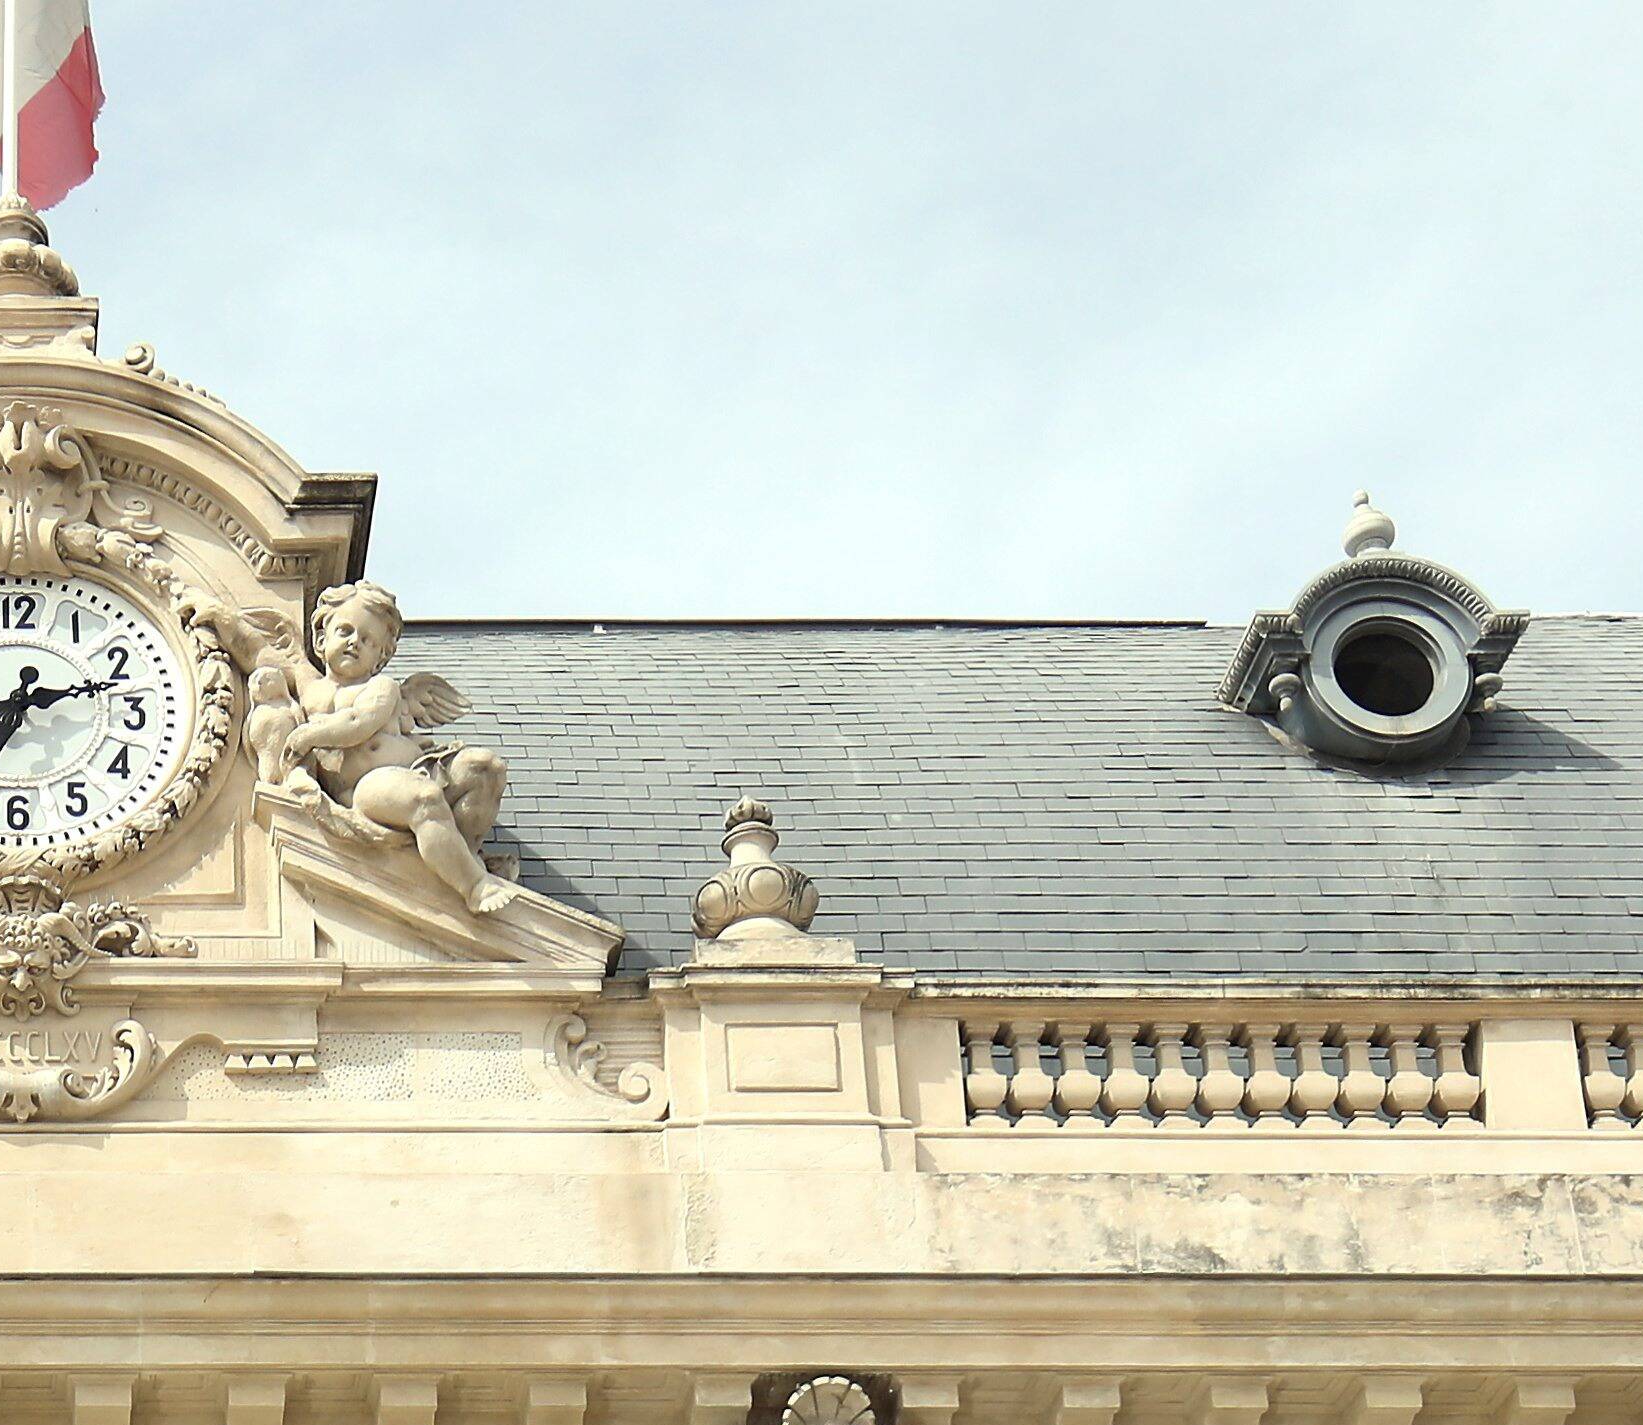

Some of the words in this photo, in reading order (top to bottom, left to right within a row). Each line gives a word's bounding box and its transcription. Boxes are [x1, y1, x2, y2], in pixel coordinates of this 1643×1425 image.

[1, 595, 36, 630] 12
[71, 609, 81, 644] 1
[107, 646, 130, 680] 2
[123, 696, 146, 731] 3
[106, 745, 130, 779] 4
[6, 795, 30, 831] 6
[65, 782, 88, 817] 5
